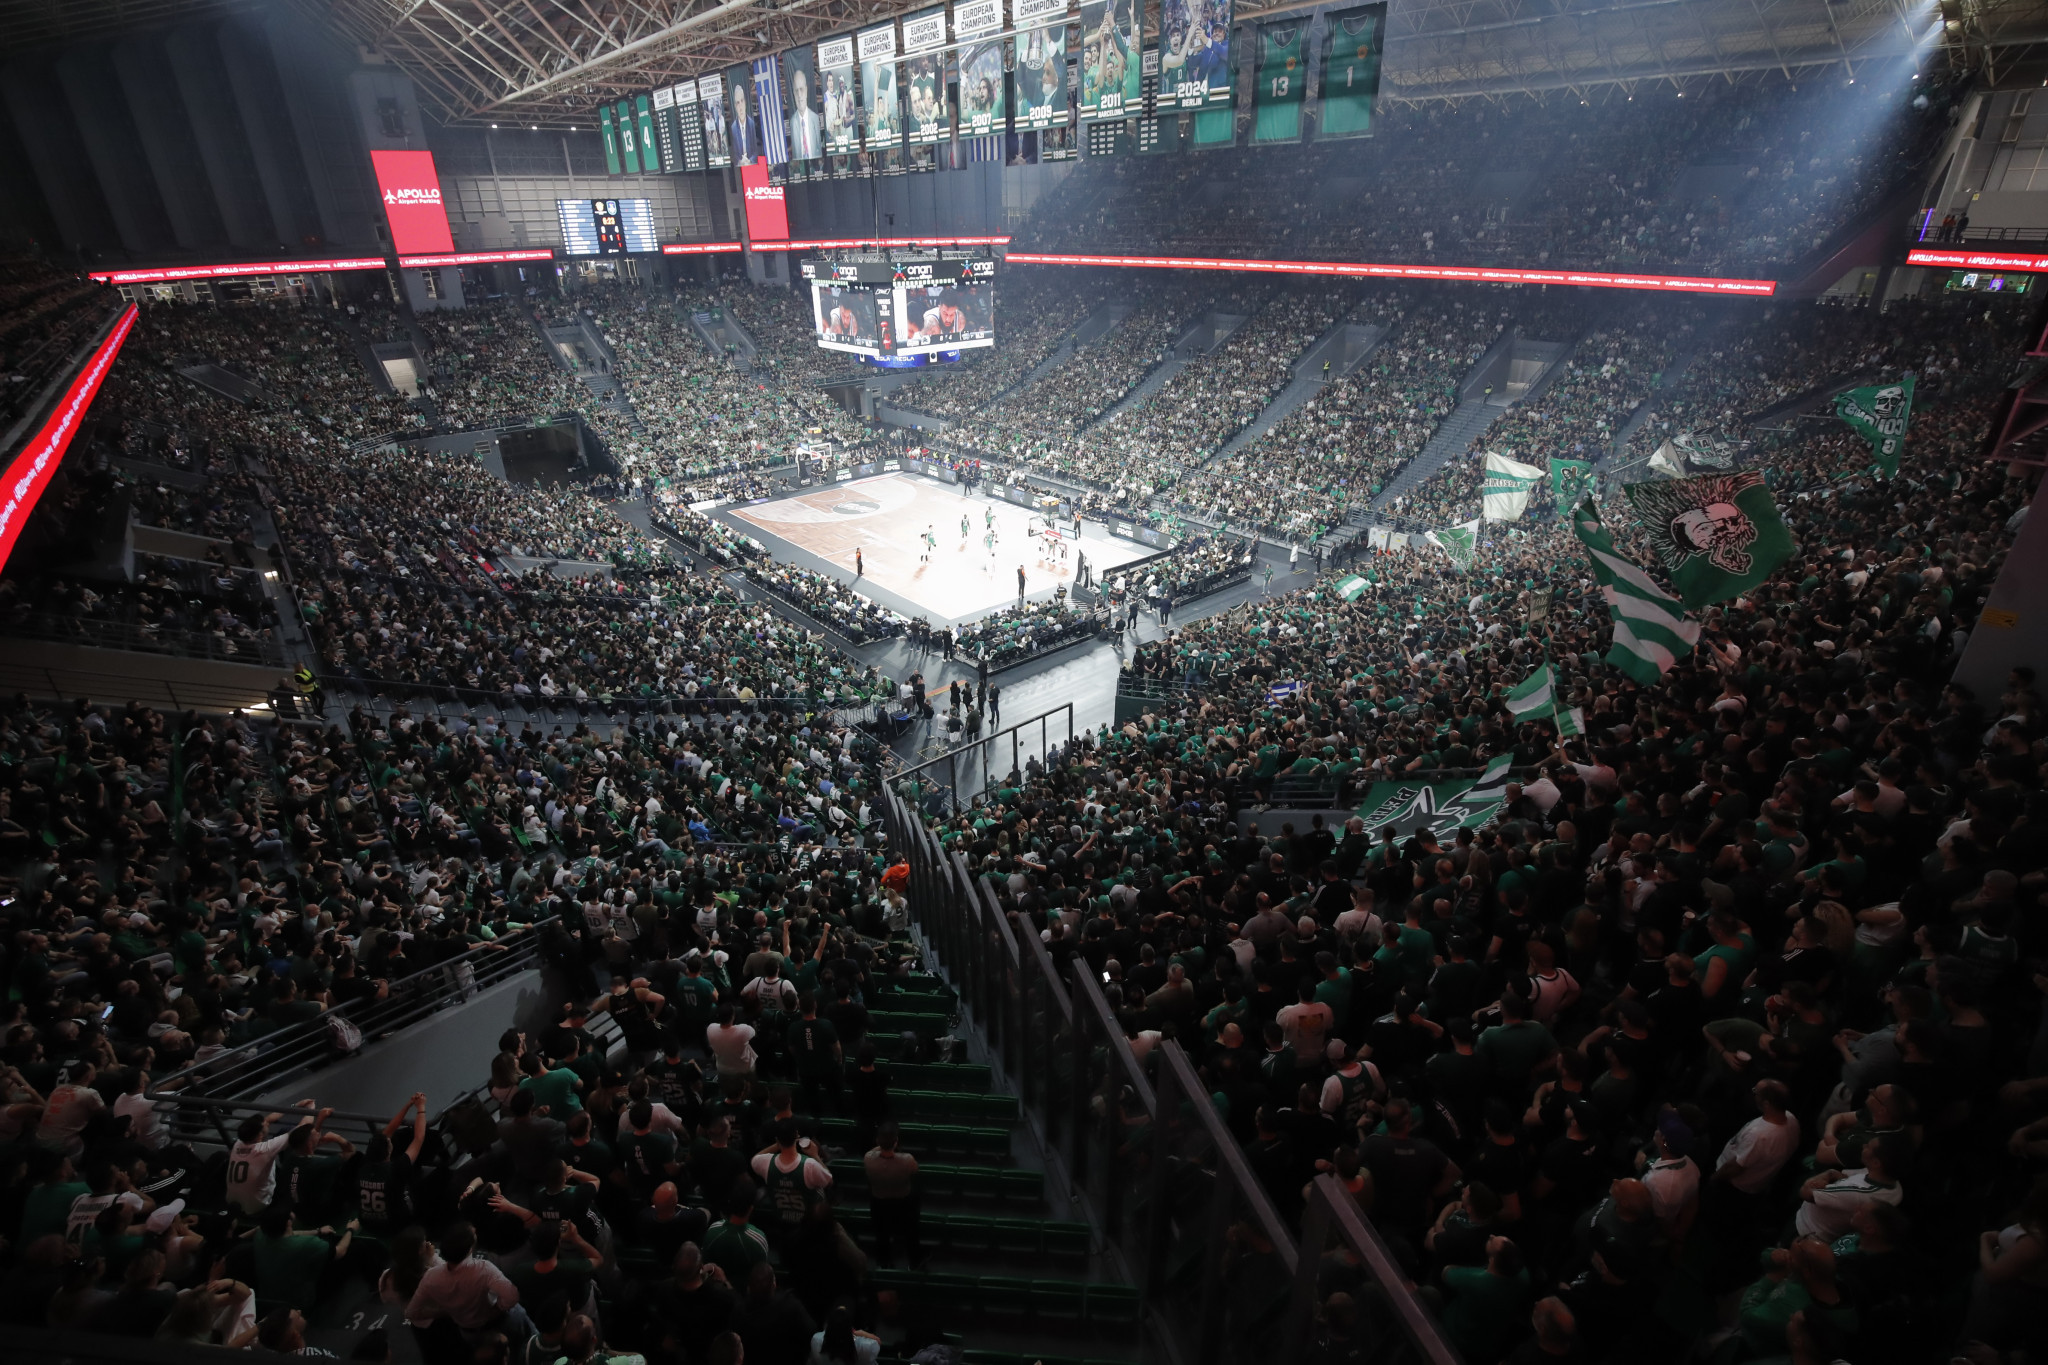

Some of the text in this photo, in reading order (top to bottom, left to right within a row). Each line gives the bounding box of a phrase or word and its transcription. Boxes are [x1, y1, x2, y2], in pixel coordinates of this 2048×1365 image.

[962, 3, 994, 20] EUROPEAN
[1020, 0, 1059, 16] CHAMPIONS
[910, 20, 938, 36] EUROPEAN
[960, 14, 996, 30] CHAMPIONS
[864, 32, 889, 46] EUROPEAN
[909, 30, 940, 46] CHAMPIONS
[824, 44, 846, 57] EUROPEAN
[863, 42, 891, 56] CHAMPIONS
[824, 53, 848, 65] CHAMPIONS
[1145, 54, 1158, 63] GREE
[1178, 80, 1208, 98] 2024
[1271, 77, 1289, 97] 13
[1100, 93, 1121, 109] 2011
[1182, 98, 1202, 107] BERLIN
[972, 113, 992, 127] 2007
[1029, 105, 1052, 120] 2009
[1098, 108, 1124, 118] BARCELONA
[875, 129, 891, 141] 2000
[920, 123, 938, 135] 2002
[608, 134, 613, 154] 1
[623, 130, 634, 152] 13
[644, 126, 651, 148] 4
[835, 135, 848, 146] 1996
[397, 189, 440, 198] APOLLO
[754, 187, 784, 195] APOLLO
[588, 918, 600, 927] 10
[662, 1083, 686, 1098] 25
[228, 1160, 249, 1184] 10
[360, 1190, 386, 1212] 26
[776, 1192, 806, 1211] 25
